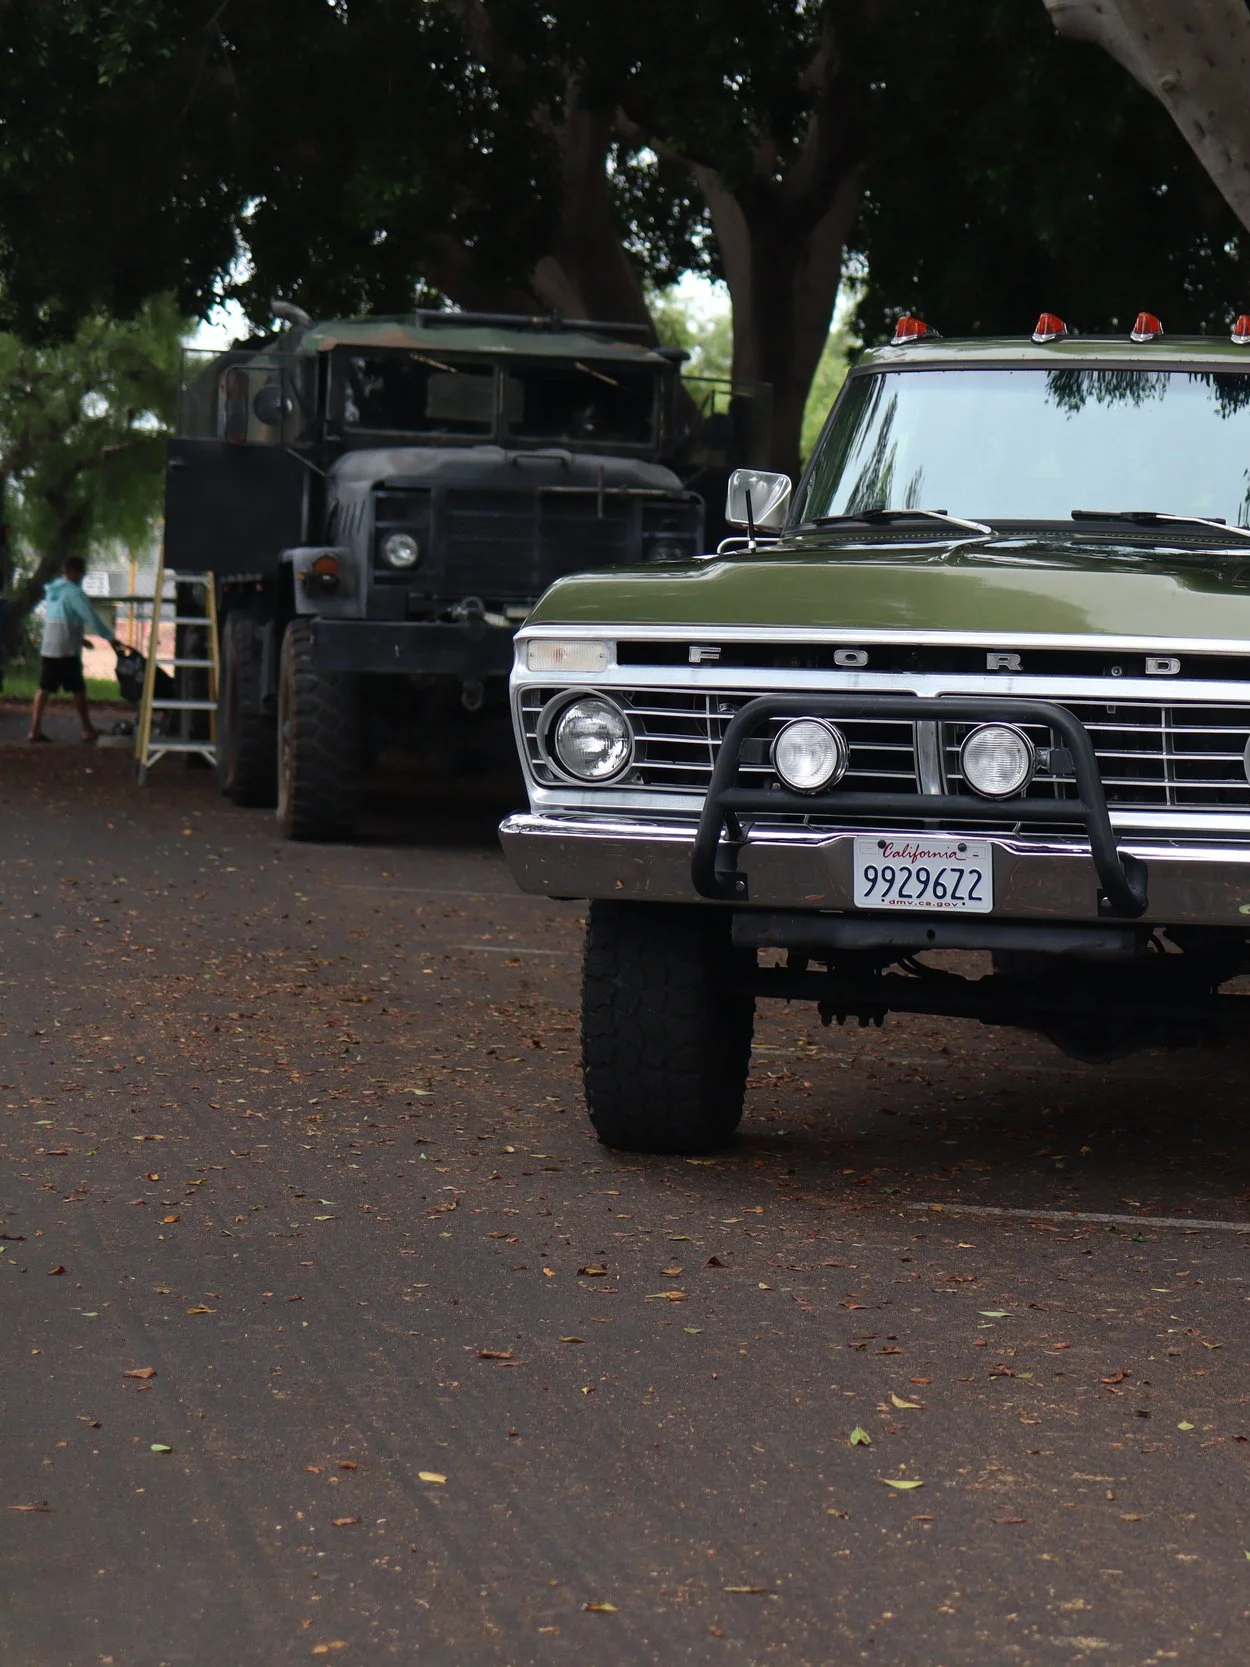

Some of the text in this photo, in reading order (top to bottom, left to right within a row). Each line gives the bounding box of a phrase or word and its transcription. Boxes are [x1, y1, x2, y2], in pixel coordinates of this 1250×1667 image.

[688, 645, 1182, 675] FORD
[882, 842, 967, 864] California
[863, 864, 983, 902] 99296Z2
[888, 899, 959, 908] dmv.ca.gov
